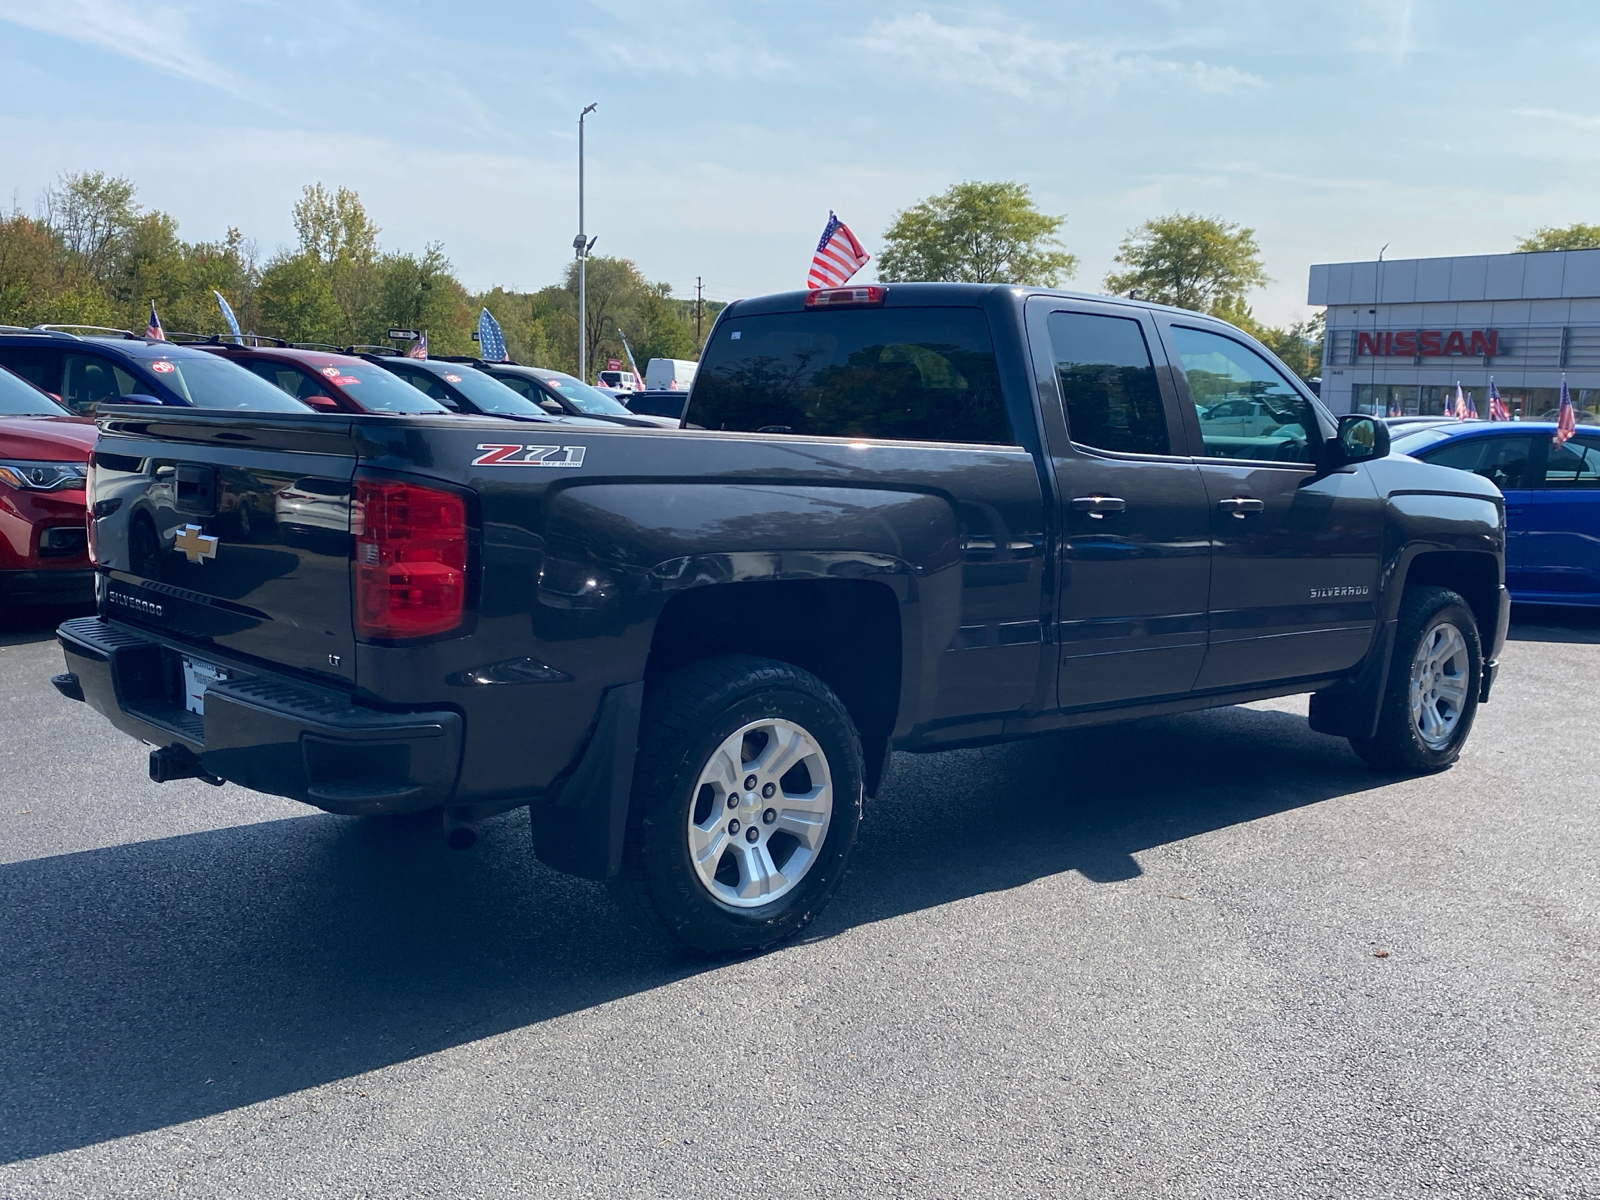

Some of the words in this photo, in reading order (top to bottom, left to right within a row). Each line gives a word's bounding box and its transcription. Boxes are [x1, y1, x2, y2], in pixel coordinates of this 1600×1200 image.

[1358, 330, 1498, 356] NISSAN
[470, 444, 586, 467] Z71
[1310, 586, 1369, 598] SILVERADO
[109, 591, 163, 617] SILVERADO
[328, 653, 341, 667] LT
